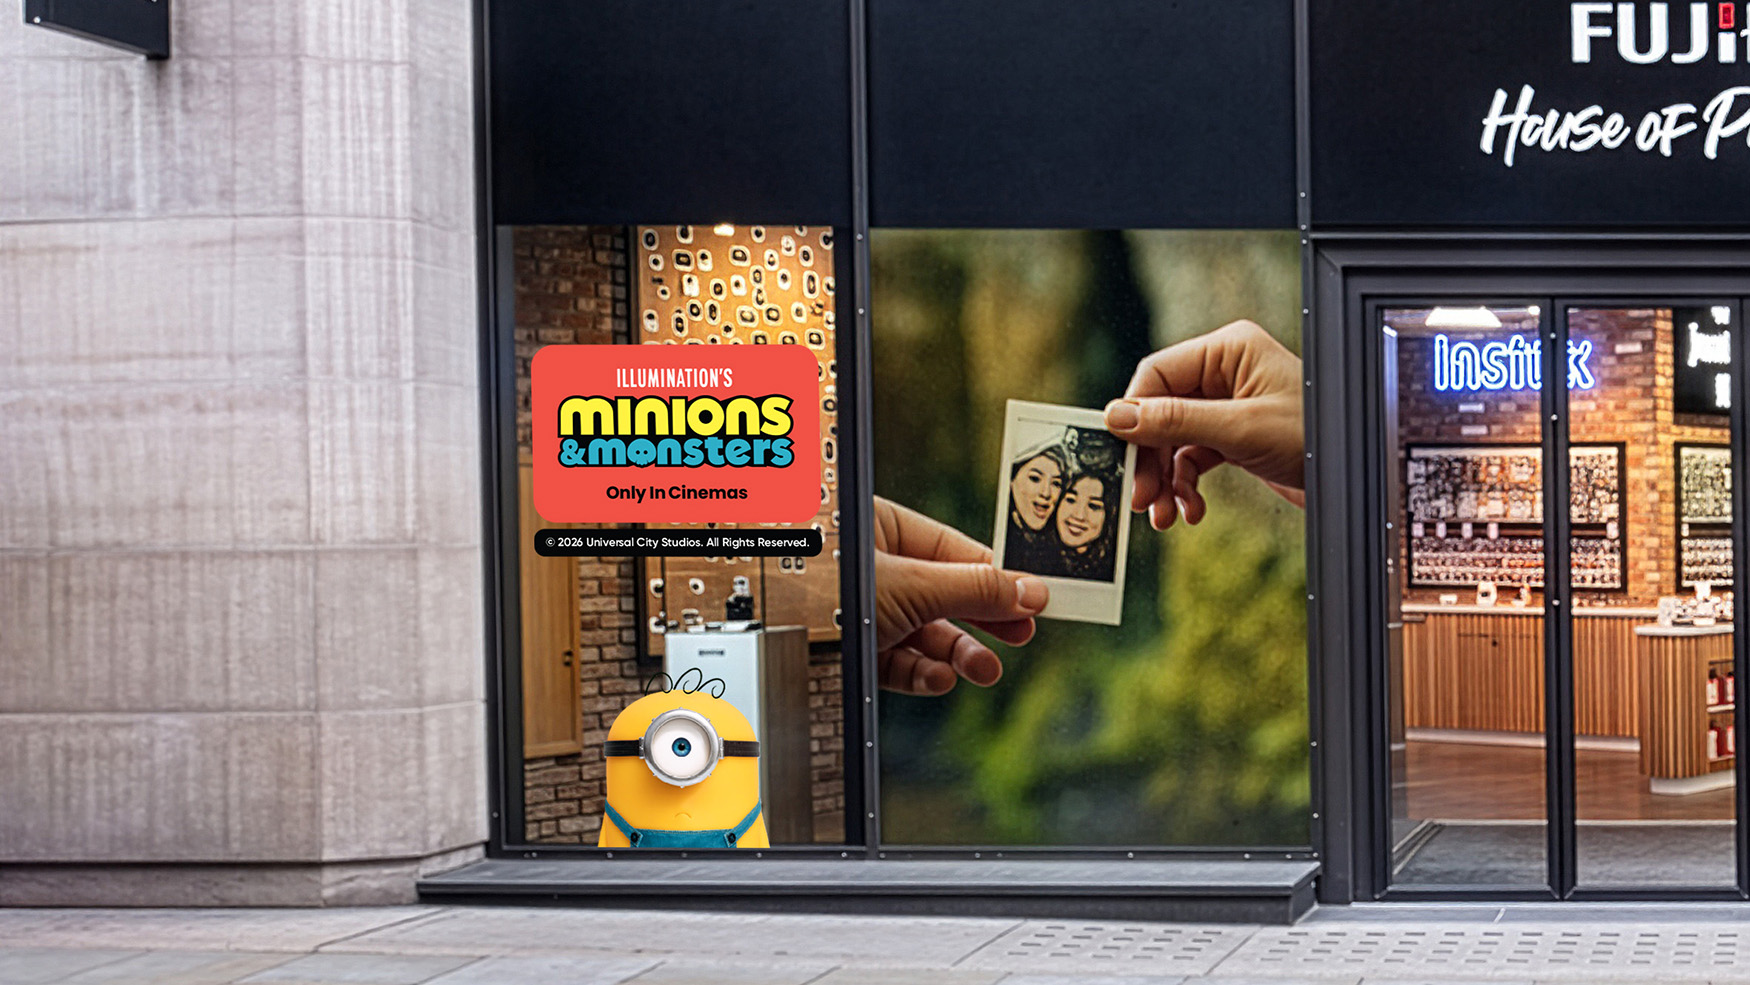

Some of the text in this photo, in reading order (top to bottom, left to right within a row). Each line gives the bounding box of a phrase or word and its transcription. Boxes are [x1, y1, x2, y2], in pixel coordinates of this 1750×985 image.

[616, 367, 733, 388] ILLUMINATION'S
[606, 484, 748, 504] Only In Cinemas
[557, 537, 584, 547] 2026
[587, 537, 635, 548] Universal
[637, 537, 659, 550] City
[661, 537, 704, 548] Studios.
[706, 537, 720, 547] All
[723, 537, 756, 550] Rights
[758, 537, 811, 548] Reserved.
